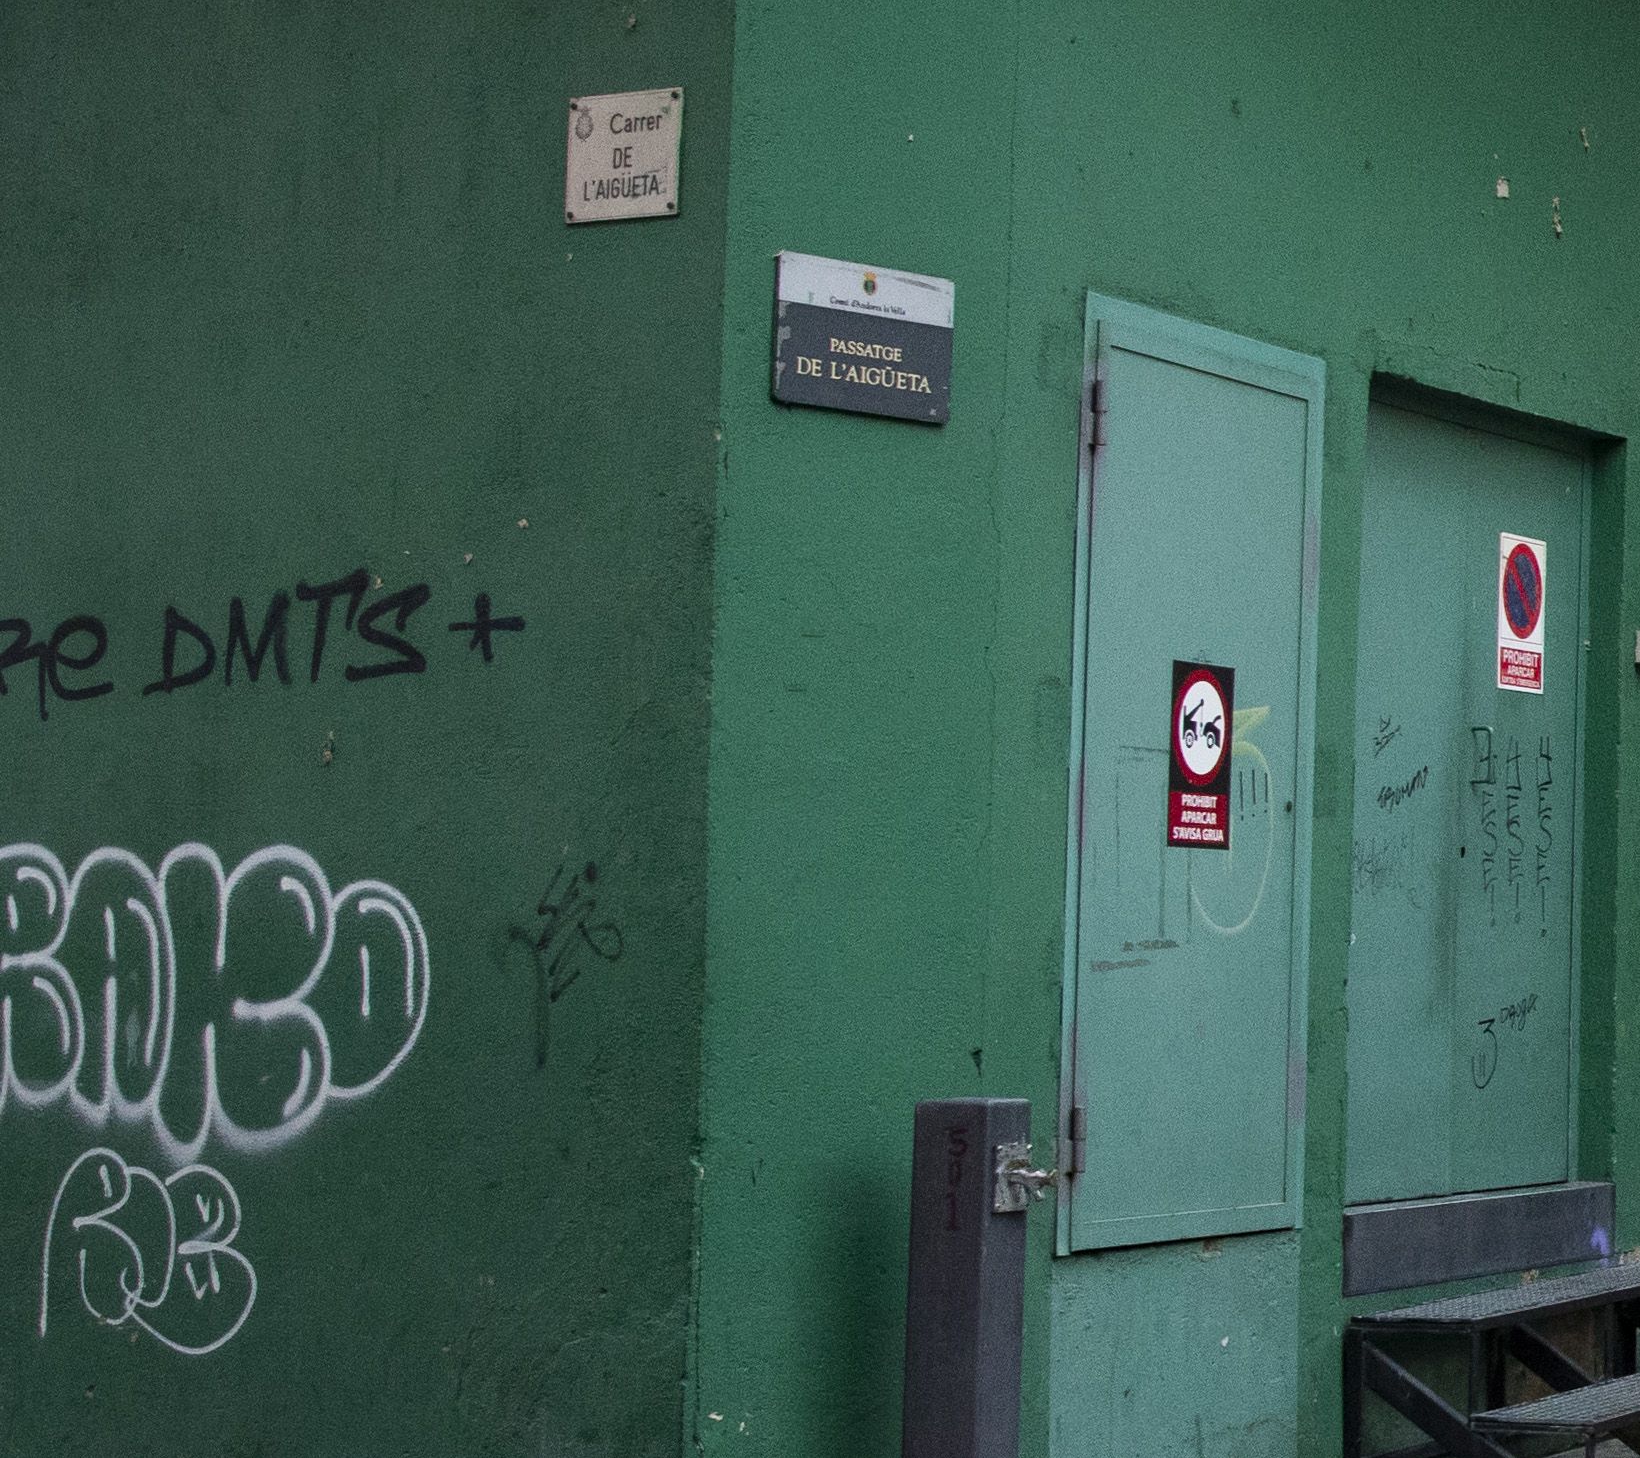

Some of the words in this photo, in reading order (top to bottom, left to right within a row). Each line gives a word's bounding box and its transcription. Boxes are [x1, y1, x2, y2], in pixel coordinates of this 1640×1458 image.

[610, 113, 662, 134] Carrer
[613, 147, 633, 169] DE
[583, 172, 660, 201] L'AIGÜETA
[830, 338, 903, 362] PASSATGE
[796, 356, 822, 377] DE
[830, 361, 932, 394] L'AIGÜETA
[1503, 649, 1539, 668] PROHIBIT
[1182, 794, 1218, 809] PROHIBIT
[1181, 811, 1217, 824] APARCAR
